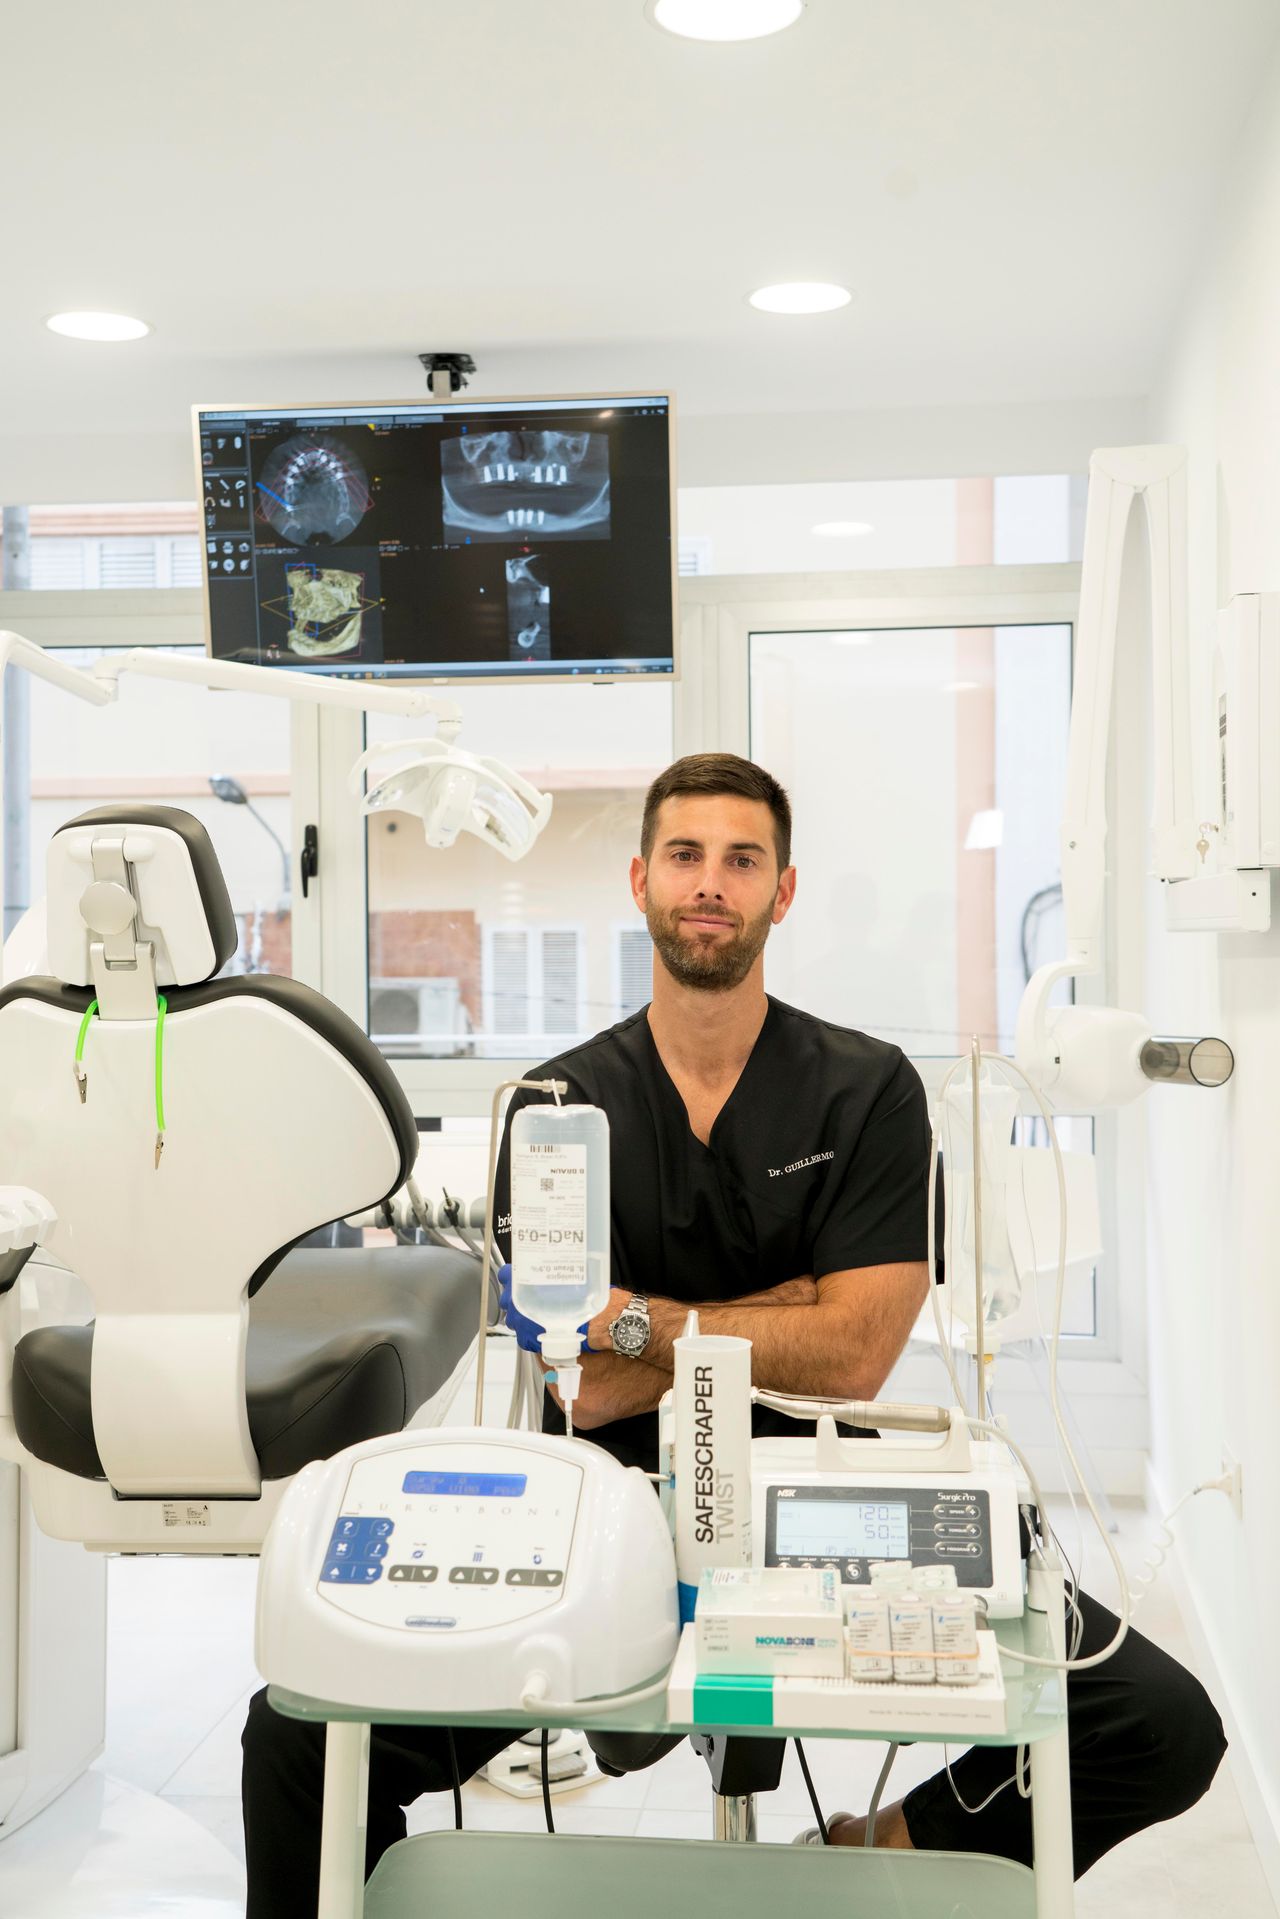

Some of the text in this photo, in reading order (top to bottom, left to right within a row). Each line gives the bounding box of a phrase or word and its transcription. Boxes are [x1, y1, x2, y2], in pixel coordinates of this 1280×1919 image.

[768, 1150, 835, 1177] Dr. GUILLERMO
[518, 1229, 584, 1244] NaCl-0,9
[694, 1366, 714, 1544] SAFESCRAPER
[777, 1489, 797, 1498] NSK
[716, 1469, 734, 1544] TWIST
[858, 1505, 889, 1521] 120
[864, 1524, 889, 1540] 50
[755, 1636, 815, 1646] NOVABONE
